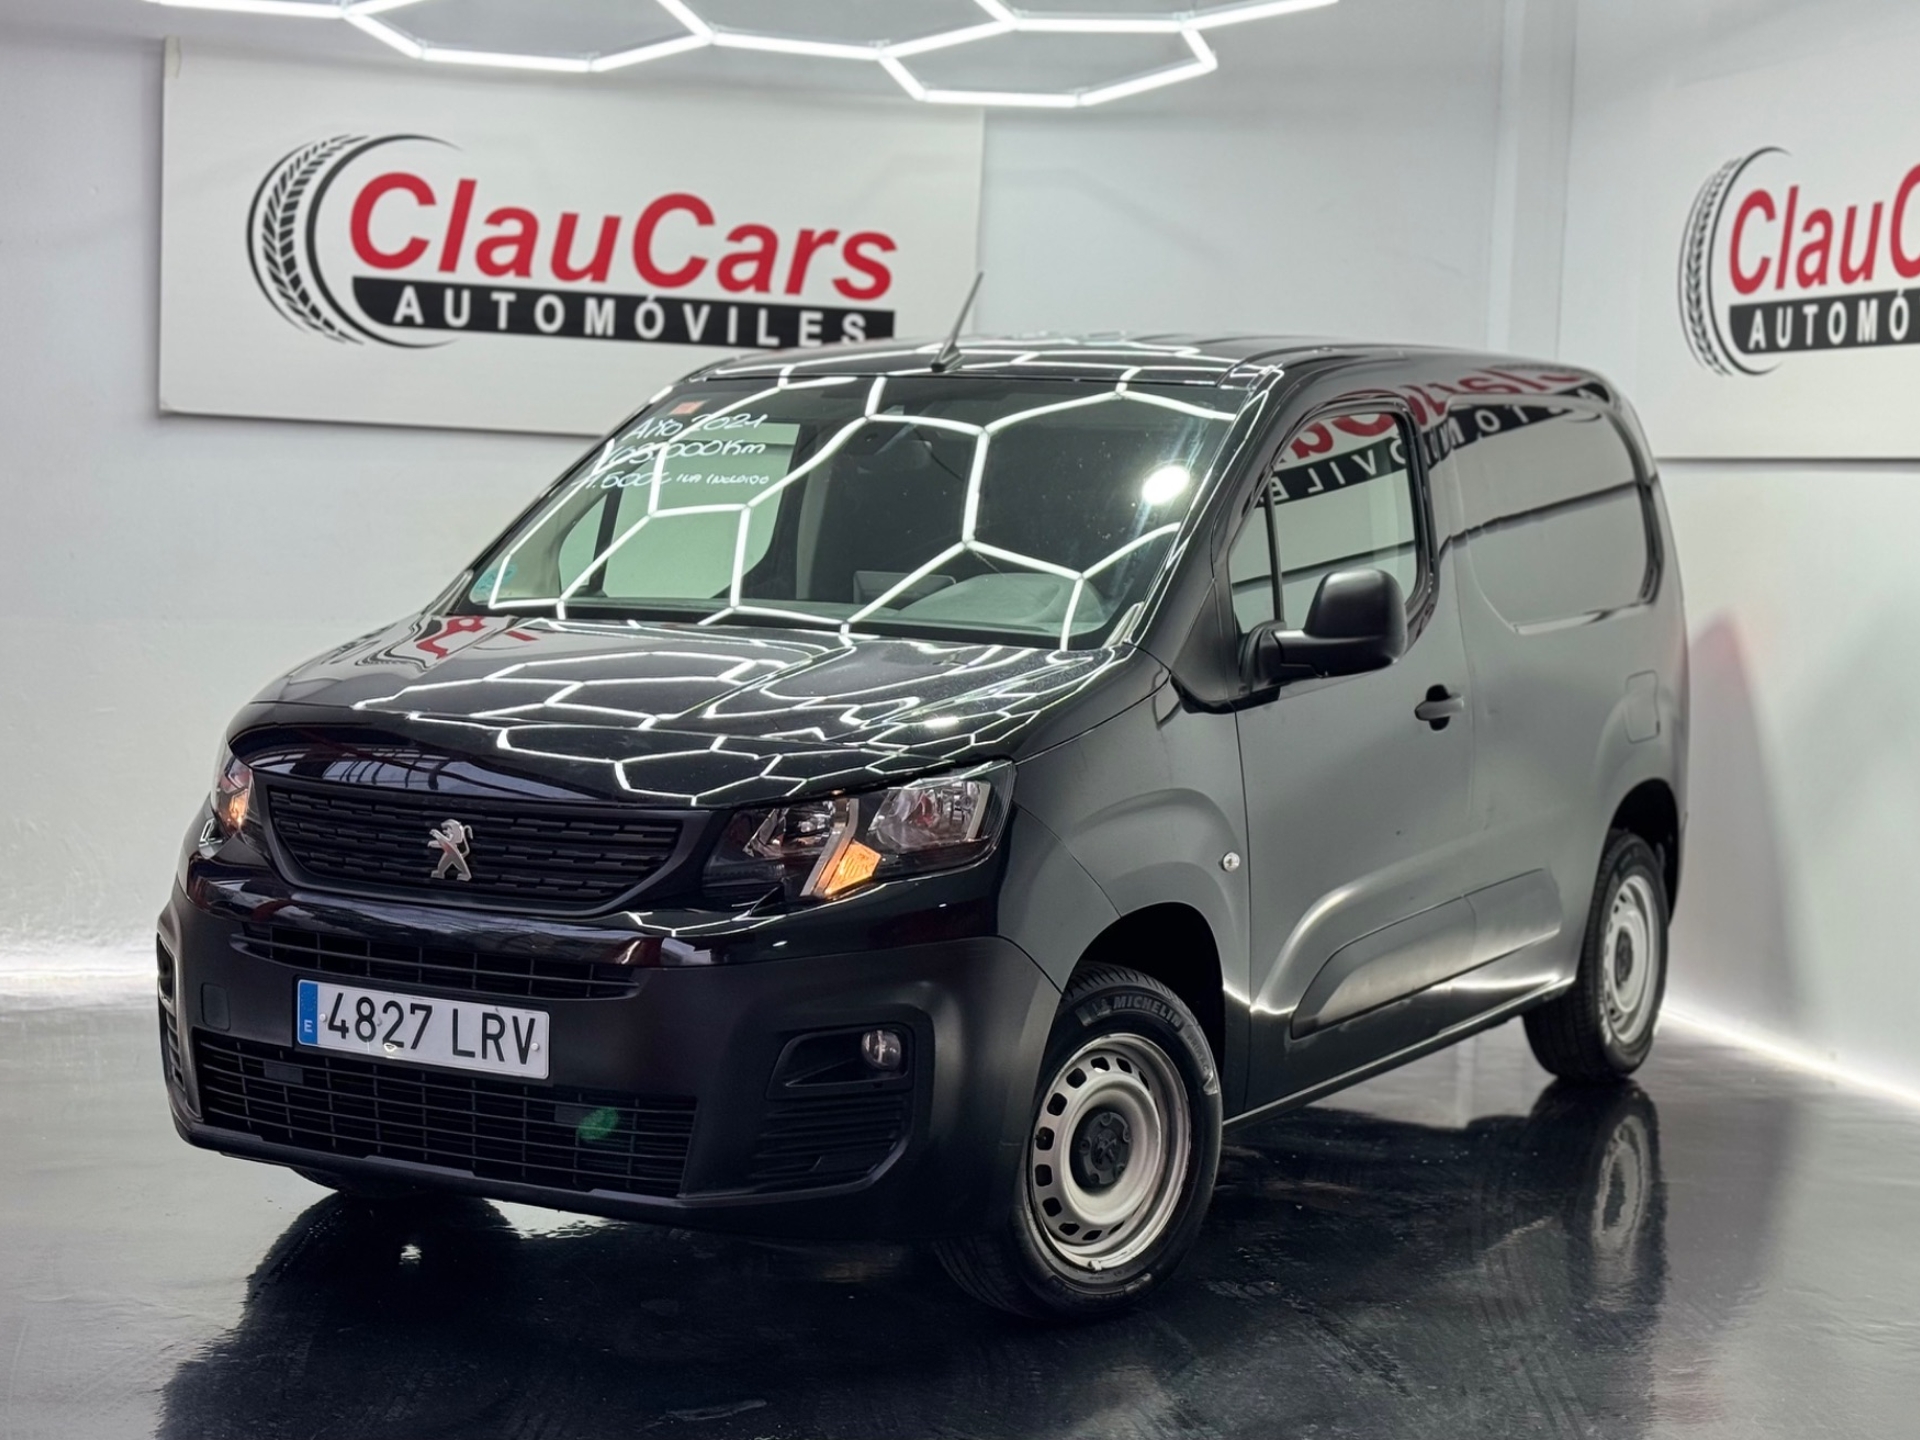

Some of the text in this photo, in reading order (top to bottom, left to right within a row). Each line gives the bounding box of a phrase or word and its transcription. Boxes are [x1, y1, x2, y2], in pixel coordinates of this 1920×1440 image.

[350, 172, 897, 300] ClauCars
[393, 285, 868, 347] AUTOMÓVILES
[304, 1019, 313, 1033] E
[328, 992, 536, 1065] 4827 LRV
[1113, 995, 1182, 1028] MICHELIN
